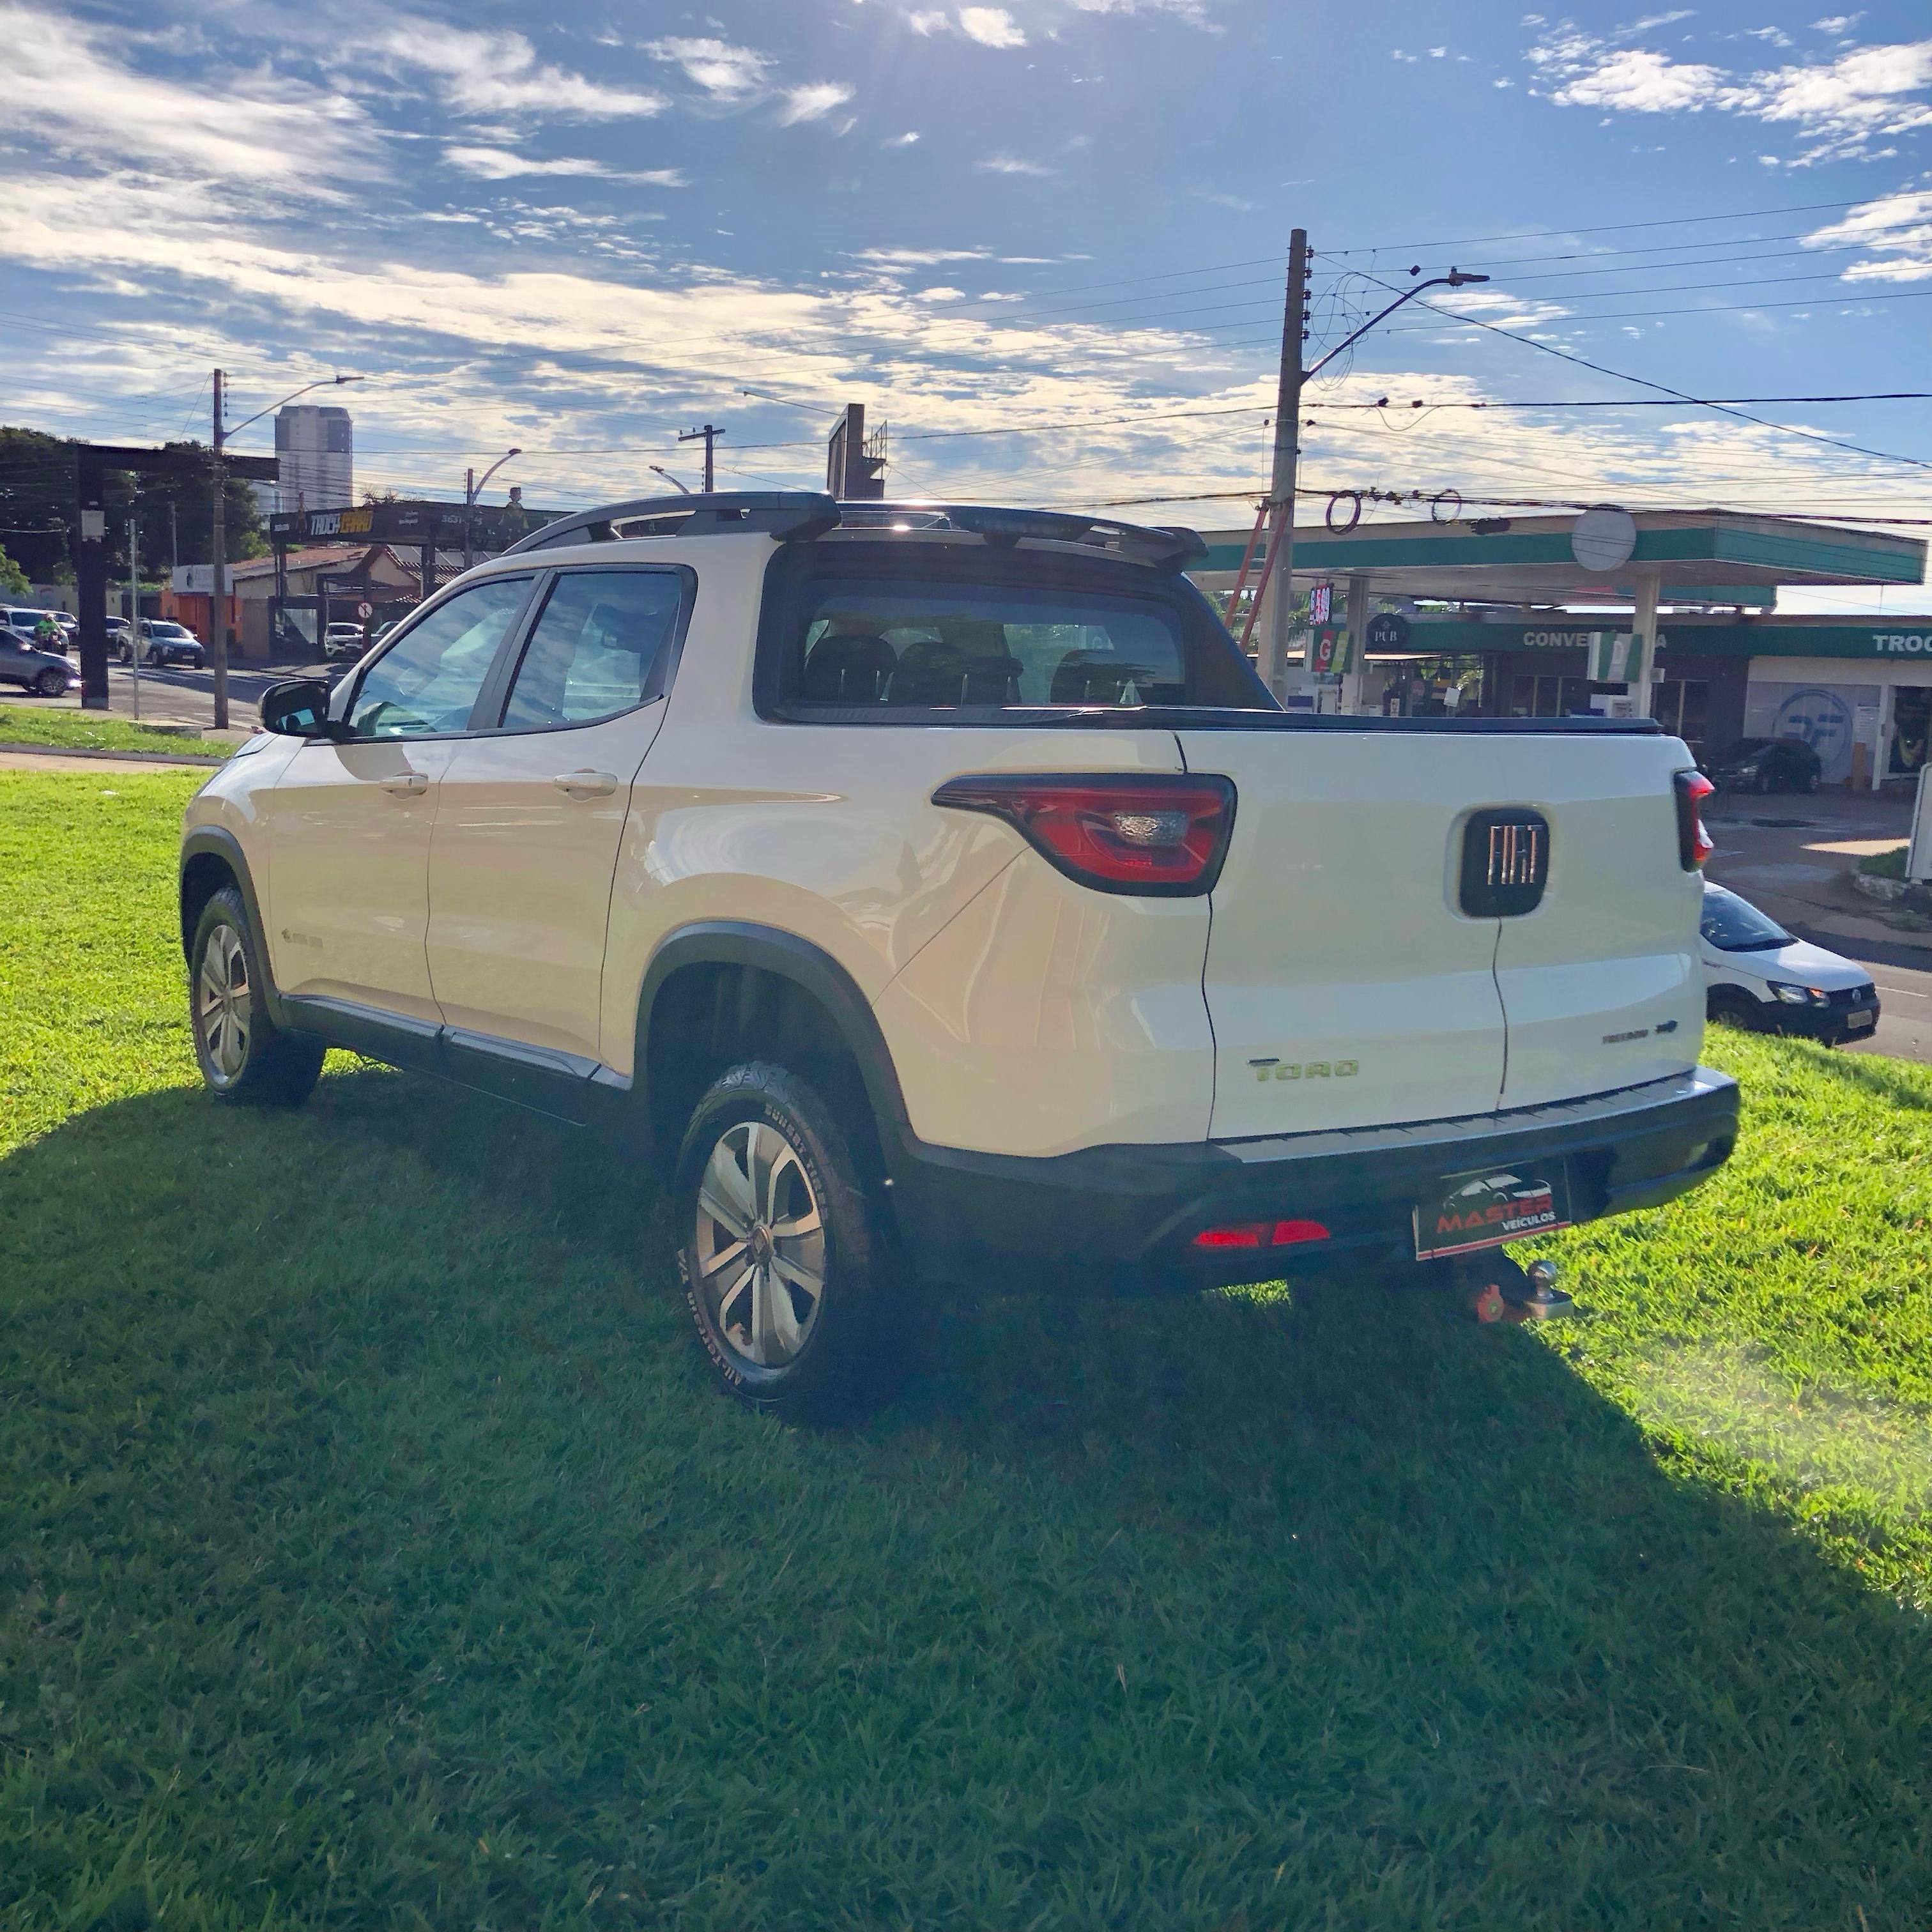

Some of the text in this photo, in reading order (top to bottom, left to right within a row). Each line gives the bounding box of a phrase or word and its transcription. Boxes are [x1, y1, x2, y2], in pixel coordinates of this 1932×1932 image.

[1375, 631, 1398, 641] PUB
[1523, 632, 1667, 648] CONVEA
[1319, 639, 1331, 661] G
[1248, 1058, 1359, 1082] TORO
[1437, 1193, 1552, 1234] MASTER
[1502, 1211, 1556, 1230] VEÍCULOS
